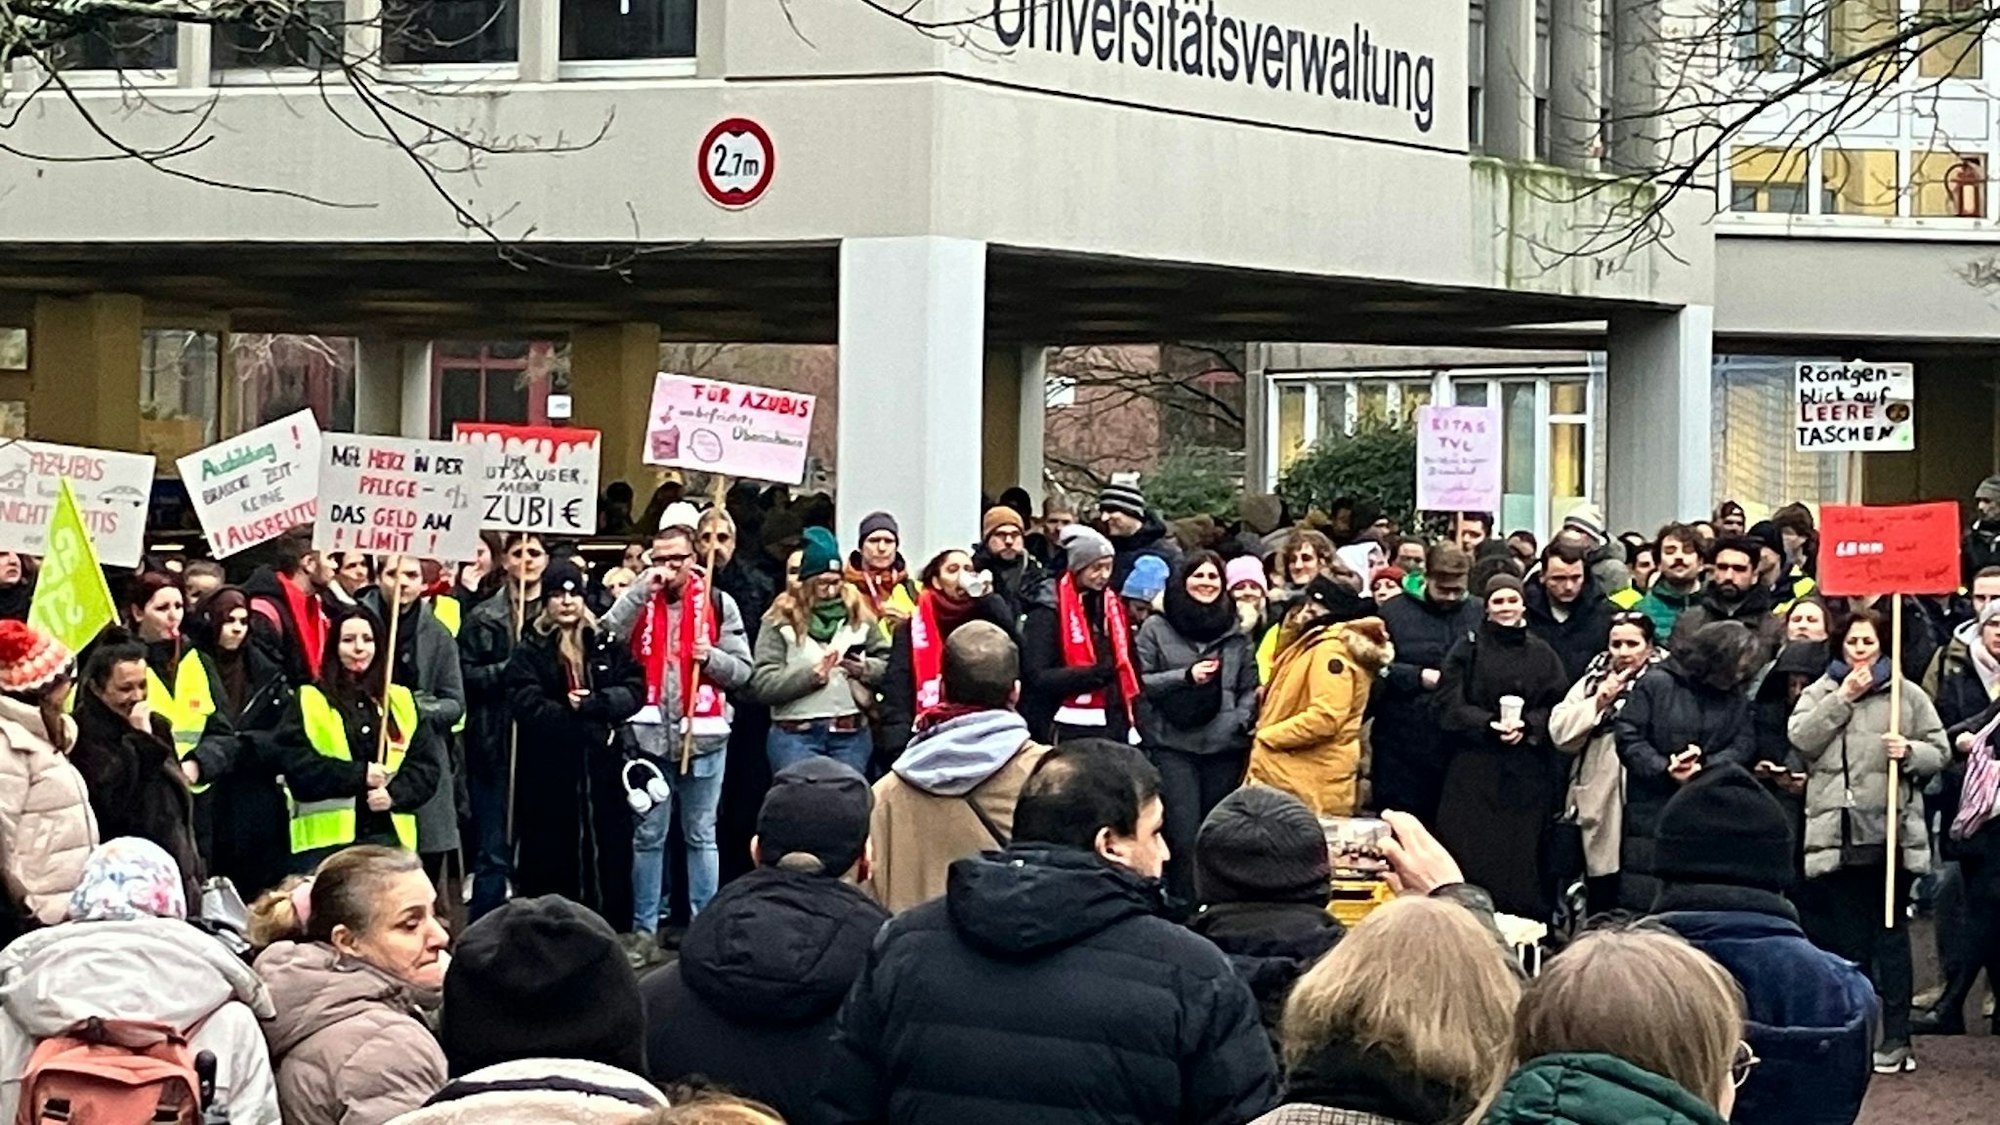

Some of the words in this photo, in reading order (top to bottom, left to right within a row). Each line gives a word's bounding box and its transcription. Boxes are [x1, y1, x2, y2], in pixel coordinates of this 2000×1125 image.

[993, 0, 1434, 132] Universitätsverwaltung
[1800, 365, 1902, 388] Röntgen-
[691, 384, 731, 404] FÜR
[740, 391, 809, 418] AZUBIS
[1800, 386, 1845, 405] blick
[1854, 387, 1891, 405] auf
[1801, 402, 1875, 422] LEERE
[1797, 425, 1894, 446] TASCHEN
[29, 451, 106, 482] AZUBIS
[368, 449, 405, 470] HERZ
[435, 456, 464, 475] DER
[358, 475, 418, 498] PFLEGE
[330, 504, 365, 524] DAS
[373, 508, 417, 528] GELD
[422, 513, 452, 531] AM
[561, 498, 583, 528] €
